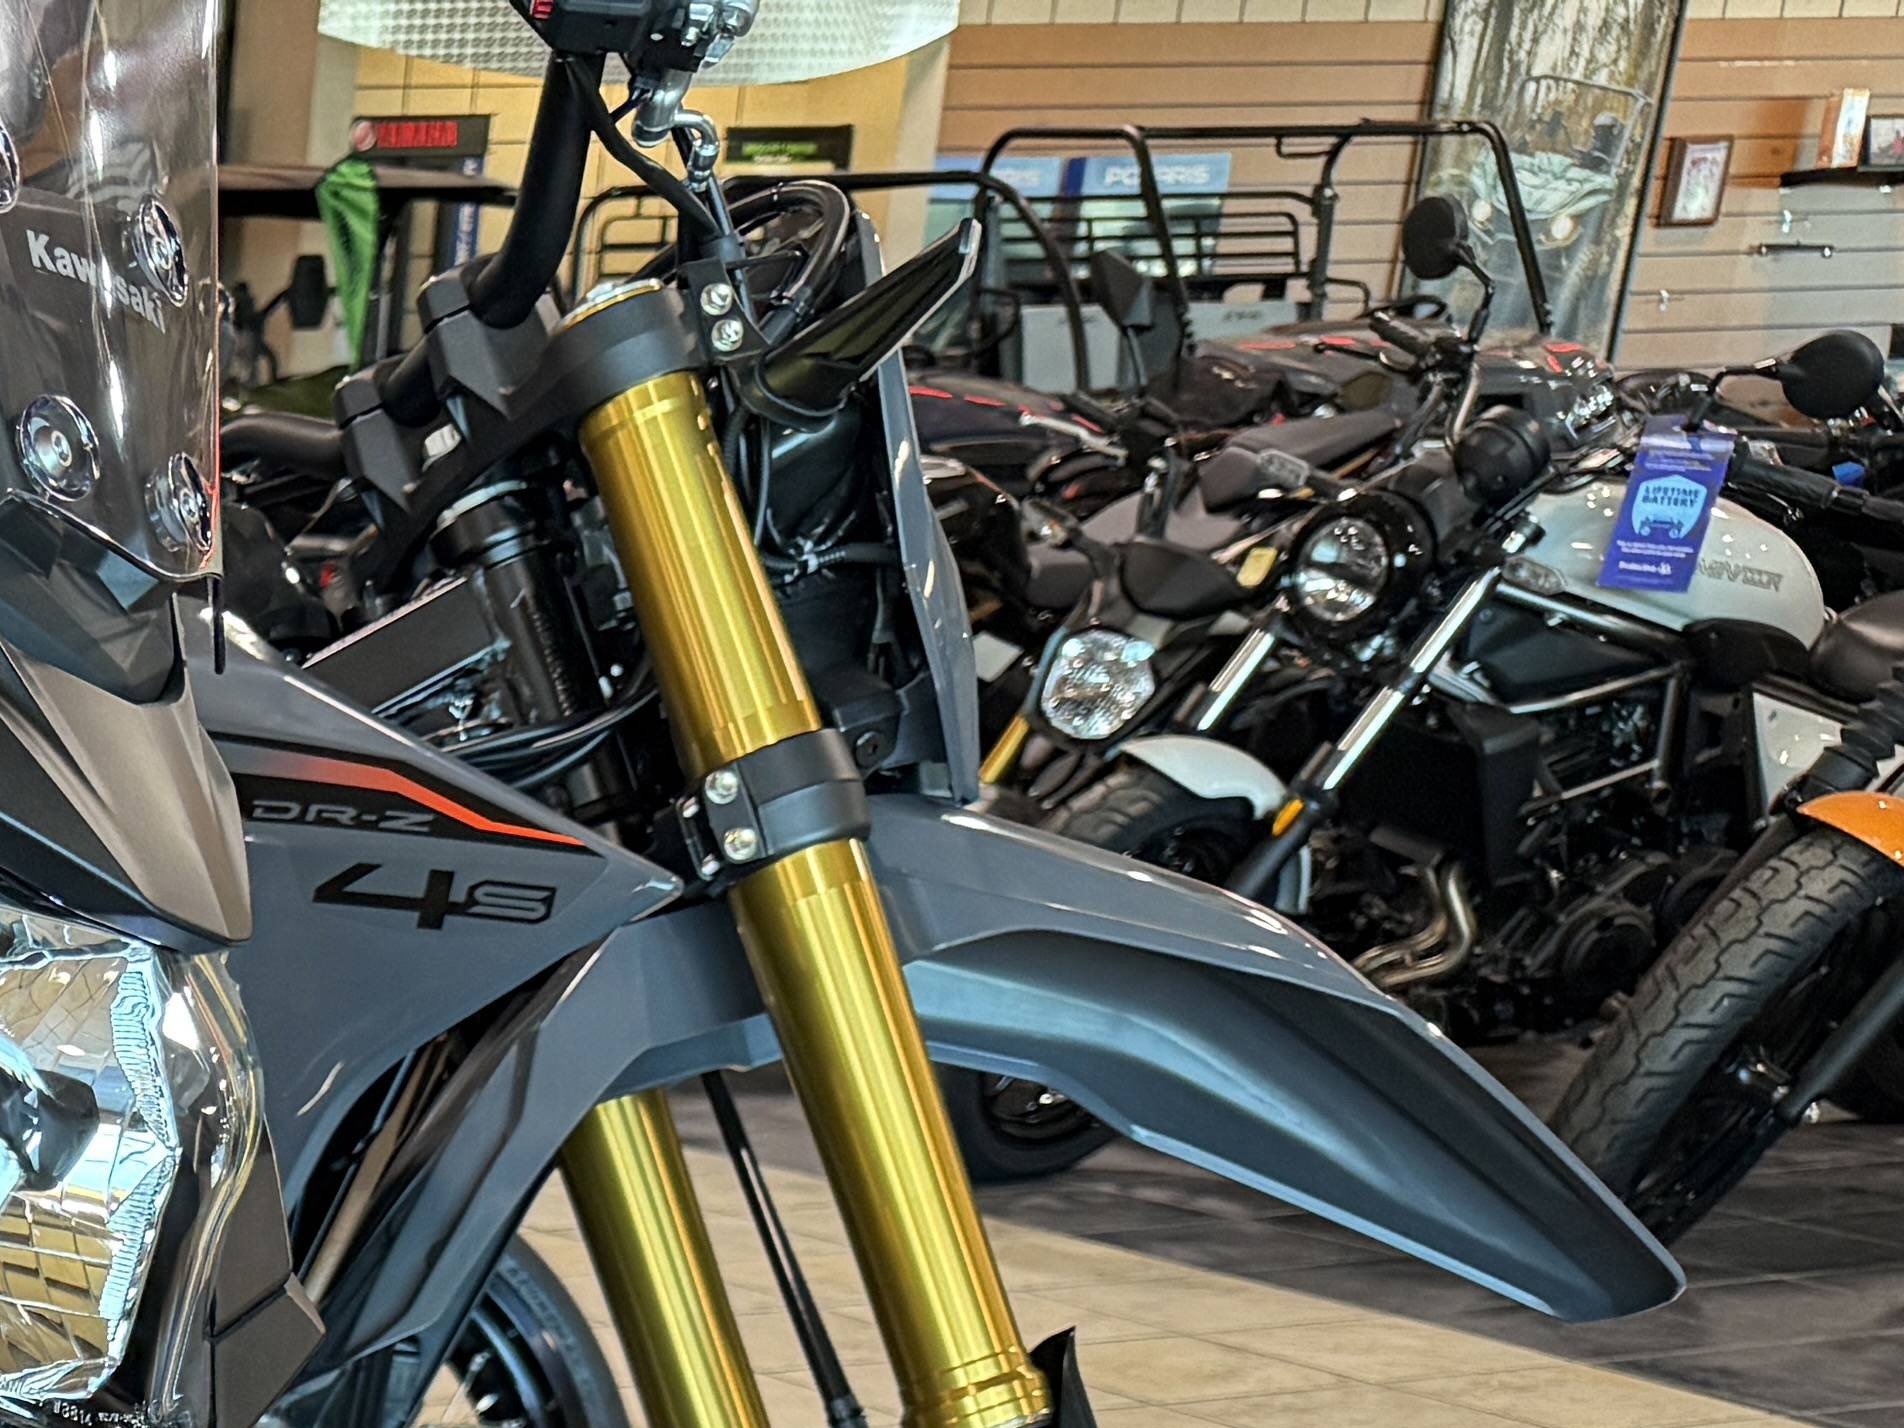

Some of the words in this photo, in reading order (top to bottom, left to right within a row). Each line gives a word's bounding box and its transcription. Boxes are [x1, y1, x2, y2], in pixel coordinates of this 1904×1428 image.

[1104, 165, 1211, 186] POARIS
[25, 228, 166, 335] Kawsaki
[1641, 495, 1698, 508] BATTERY
[252, 799, 435, 833] DR-Z
[311, 861, 557, 931] 4S
